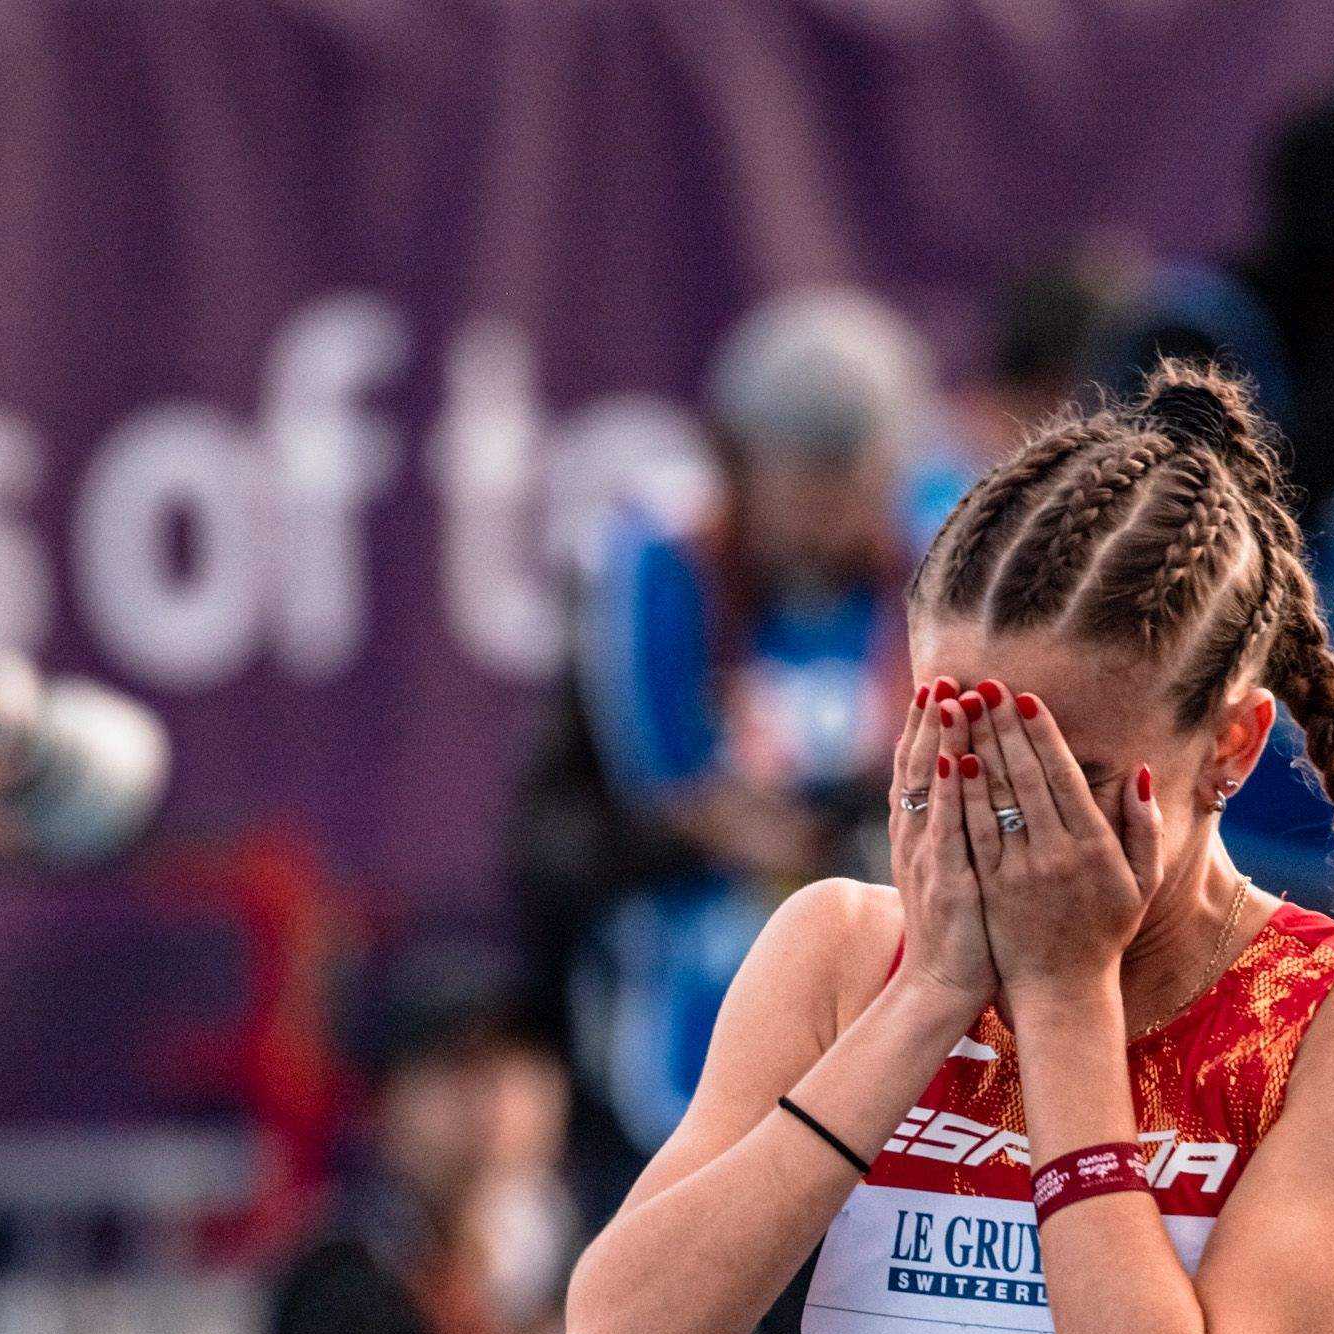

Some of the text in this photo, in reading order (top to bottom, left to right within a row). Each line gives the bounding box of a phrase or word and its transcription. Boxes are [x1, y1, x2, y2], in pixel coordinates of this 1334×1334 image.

[891, 1209, 1044, 1274] LE GRUY
[897, 1271, 1047, 1303] SWITZERL
